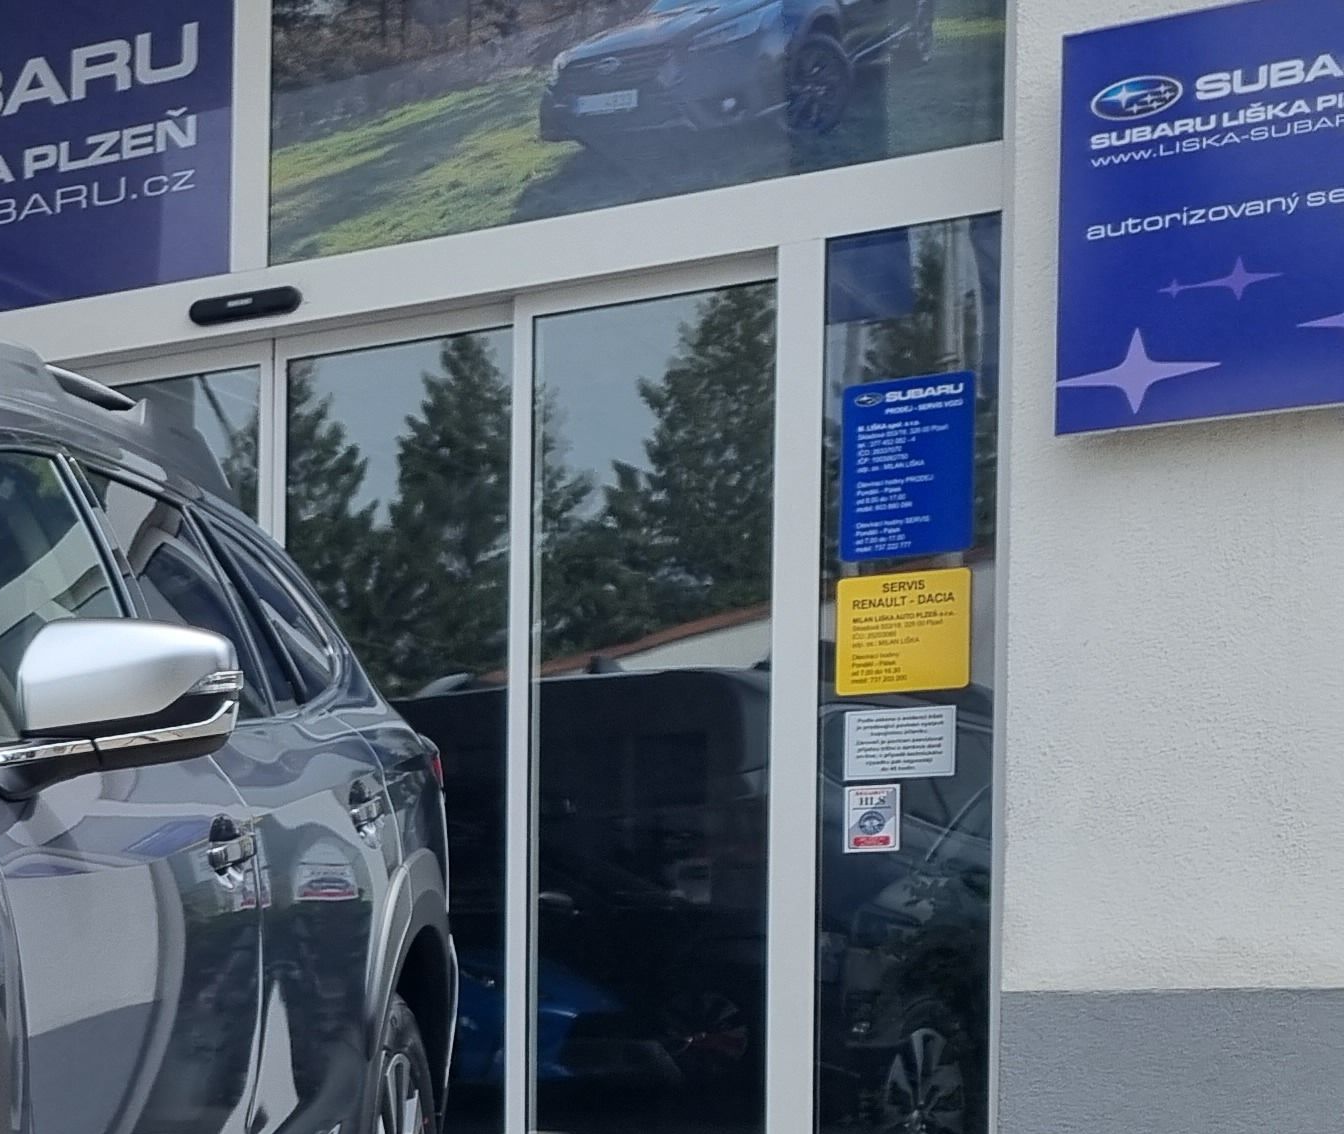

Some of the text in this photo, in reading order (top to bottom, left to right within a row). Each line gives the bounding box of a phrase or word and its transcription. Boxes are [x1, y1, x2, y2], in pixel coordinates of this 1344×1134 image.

[1090, 114, 1216, 150] SUBARU
[1222, 102, 1312, 128] LIŠKA
[23, 107, 198, 180] PLZEŇ
[1086, 192, 1299, 240] autorizovaný
[885, 382, 964, 403] SUBARU
[852, 596, 907, 610] RENAULT
[918, 592, 955, 604] DACIA
[882, 579, 926, 593] SERVIS
